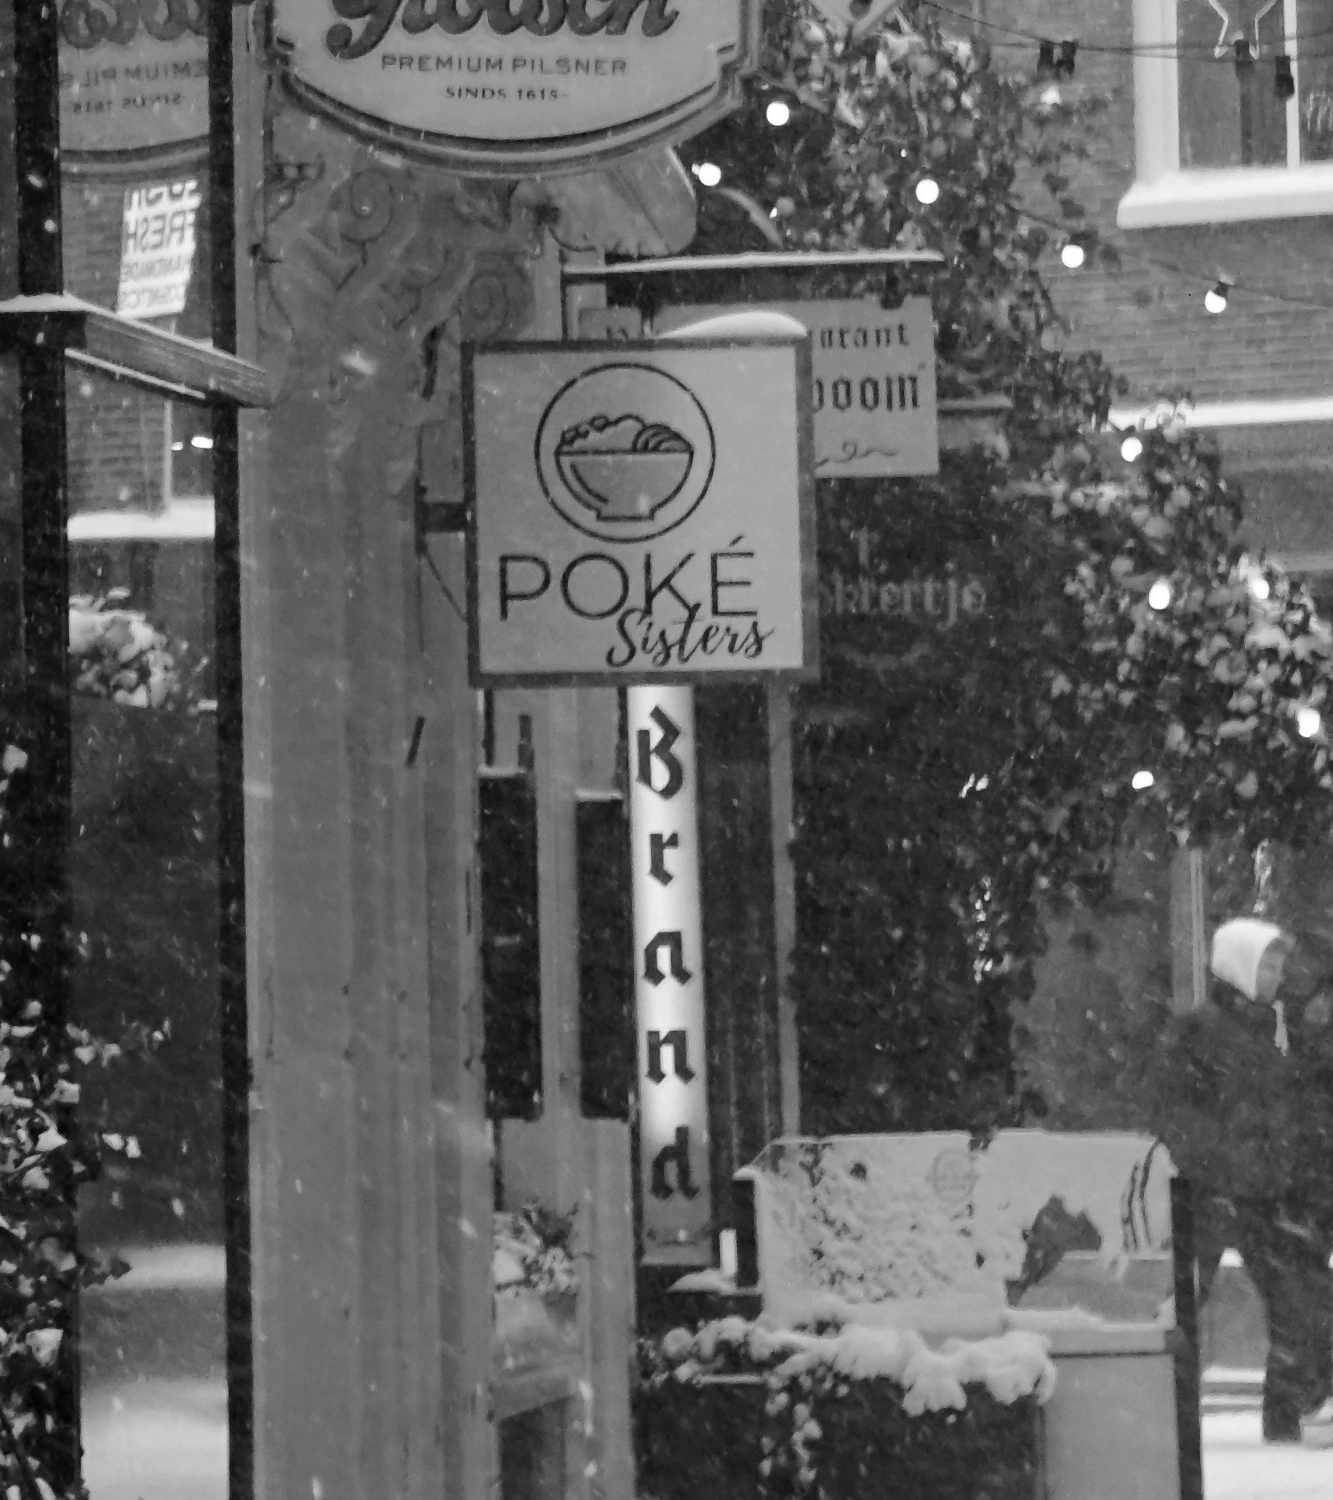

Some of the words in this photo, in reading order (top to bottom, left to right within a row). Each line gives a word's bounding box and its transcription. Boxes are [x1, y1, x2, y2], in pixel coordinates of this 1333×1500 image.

[380, 53, 503, 74] PREMIUM
[511, 55, 627, 77] PILSNER
[445, 86, 507, 100] SINDS
[497, 535, 759, 622] POKÉ
[606, 602, 775, 669] Sisters
[635, 705, 701, 1202] Brand
